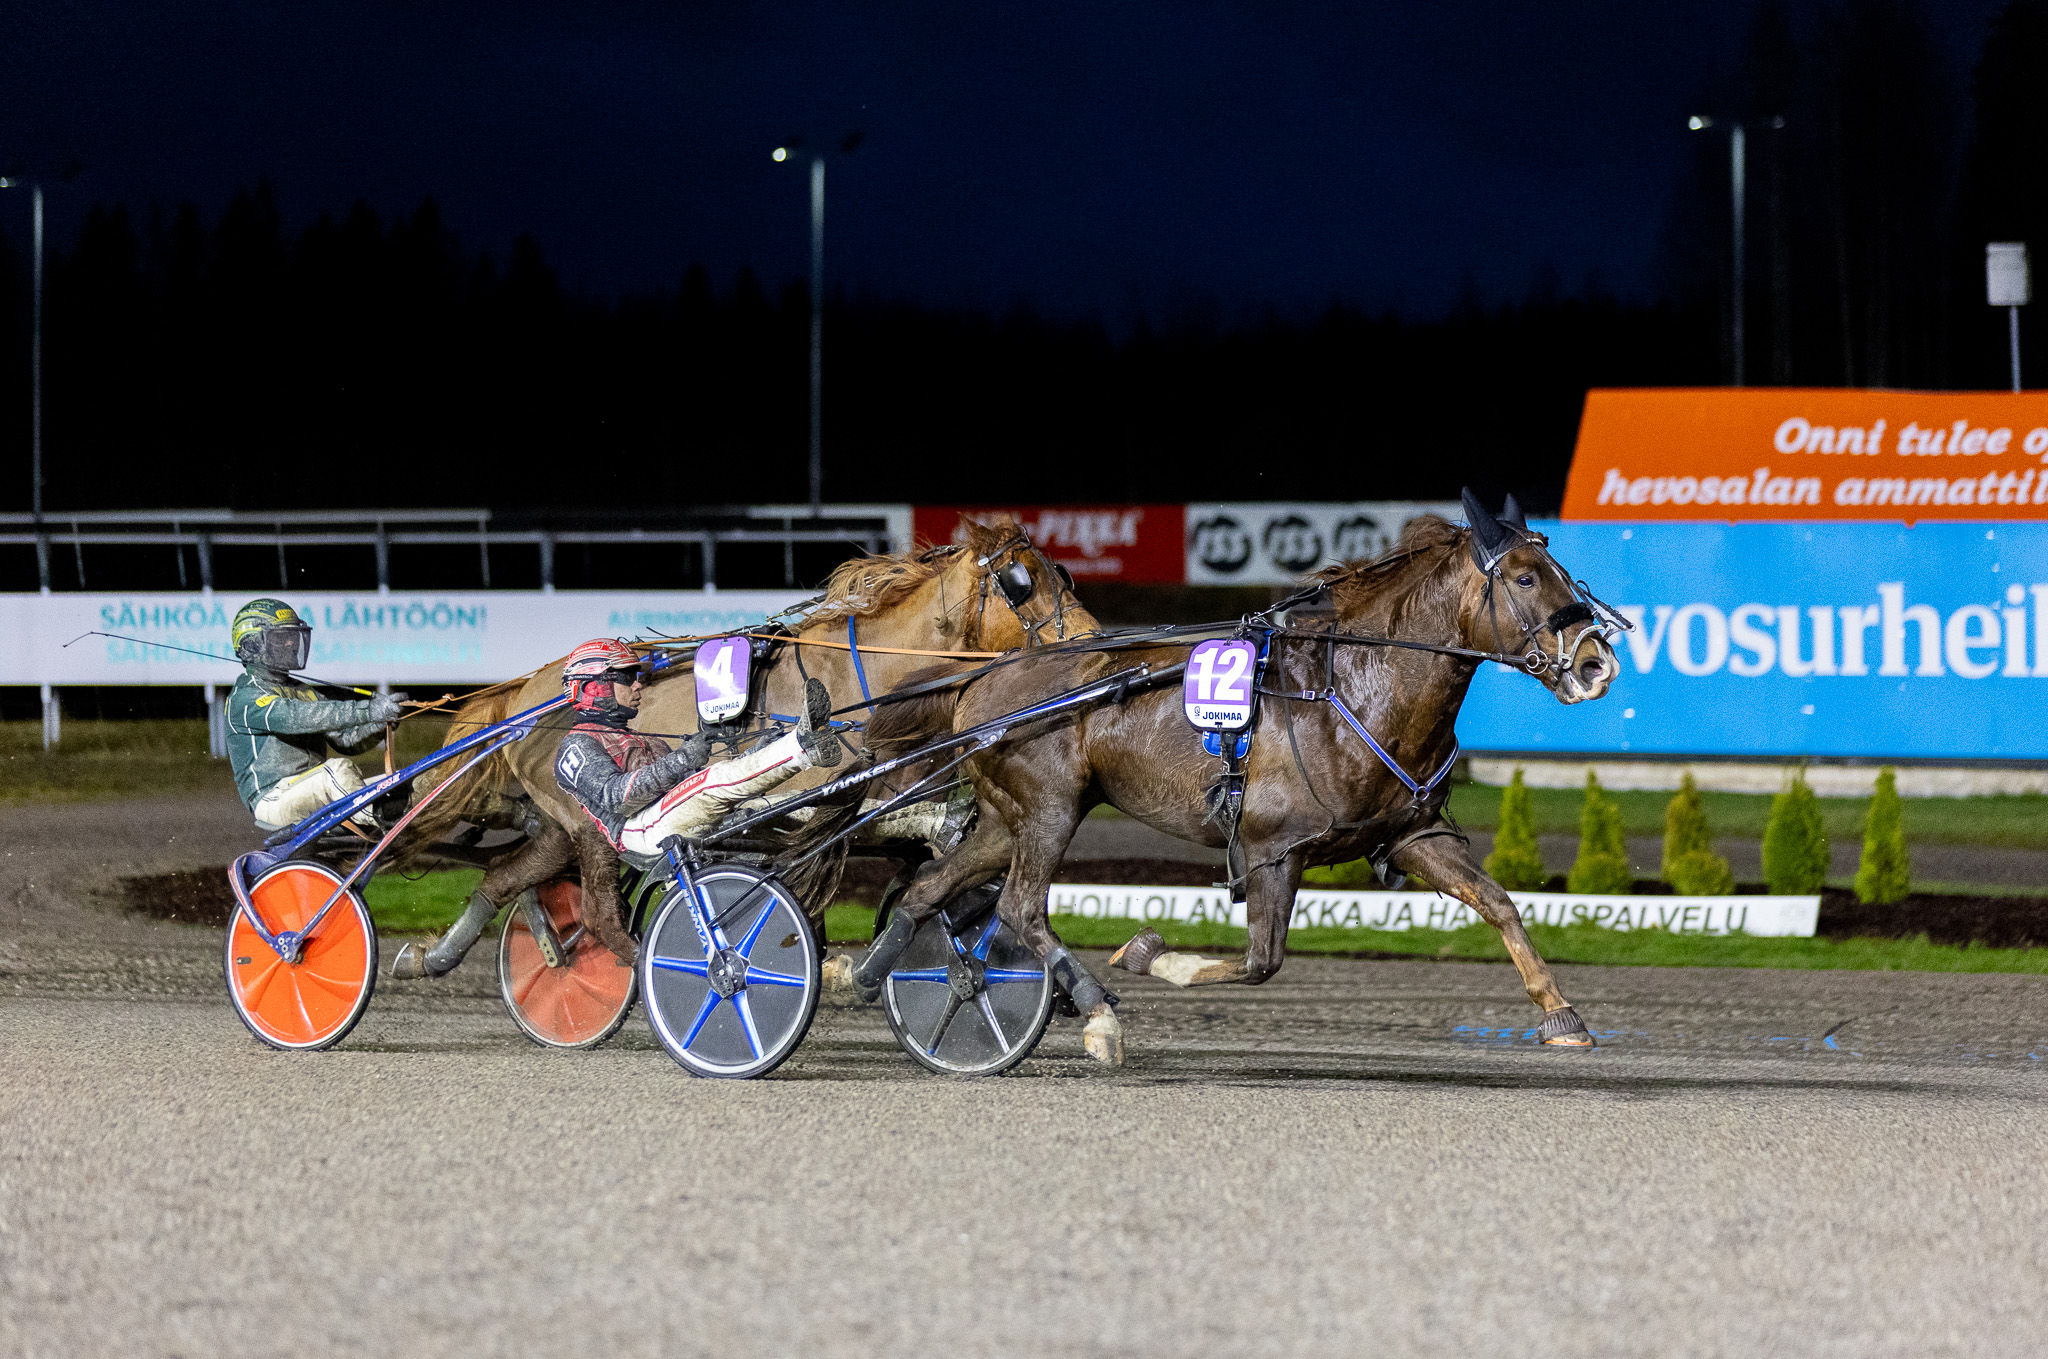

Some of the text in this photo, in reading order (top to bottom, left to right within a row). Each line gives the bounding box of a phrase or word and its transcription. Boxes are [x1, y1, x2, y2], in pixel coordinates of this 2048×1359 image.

[1774, 417, 2048, 464] Onni tulee o
[1597, 466, 1821, 506] hevosalan
[99, 600, 229, 630] SÄHKÖÄ
[325, 600, 488, 631] LÄHTÖÖN!
[707, 646, 734, 697] 4
[1193, 648, 1248, 701] 12
[711, 701, 740, 714] JOKIMAA
[1202, 711, 1243, 721] JOKIMAA
[821, 758, 897, 797] YANKEE
[1293, 899, 1363, 929] KKA
[1372, 901, 1414, 931] JA
